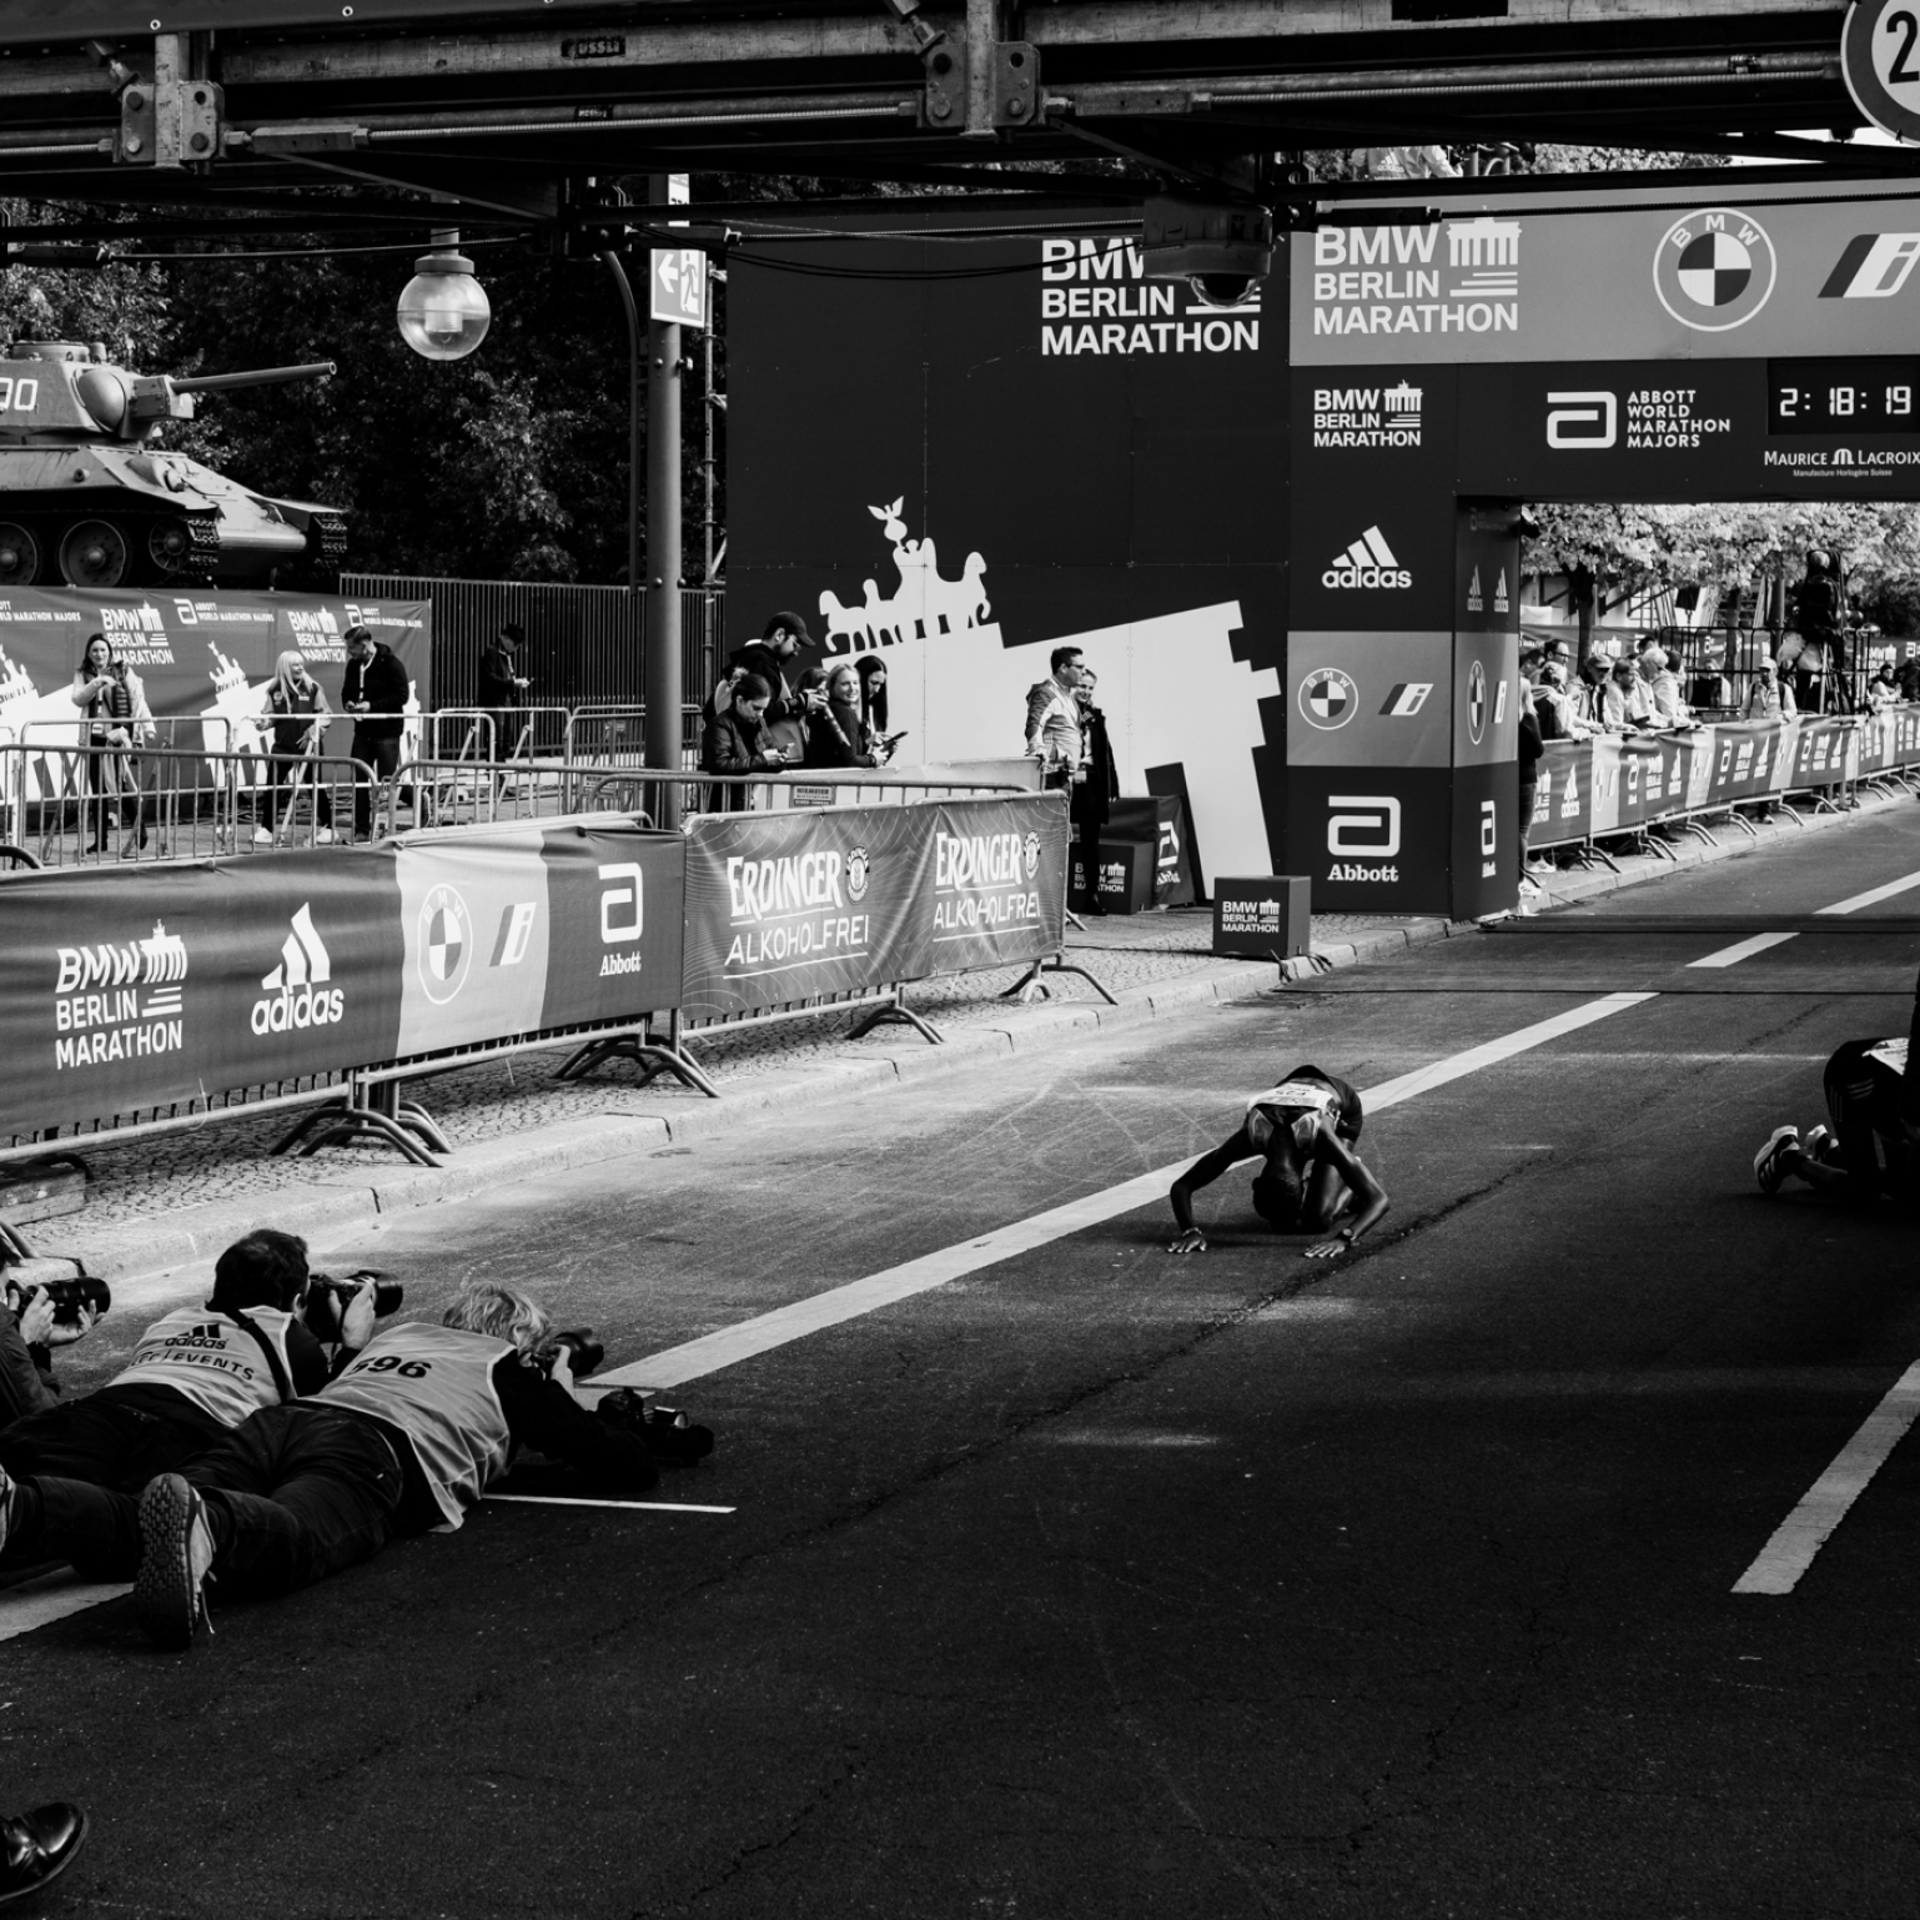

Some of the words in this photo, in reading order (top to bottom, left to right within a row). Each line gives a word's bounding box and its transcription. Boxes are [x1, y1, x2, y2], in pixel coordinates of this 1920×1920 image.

[1671, 213, 1760, 249] BMW
[1314, 224, 1438, 266] BMW
[1314, 270, 1439, 300] BERLIN
[1042, 286, 1174, 318] BERLIN
[1314, 303, 1518, 335] MARATHON
[1042, 320, 1260, 355] MARATHON
[1313, 389, 1380, 411] BMW
[1627, 390, 1696, 404] ABBOTT
[1313, 413, 1381, 429] BERLIN
[1627, 405, 1691, 418] WORLD
[1627, 419, 1731, 433] MARATHON
[1313, 431, 1421, 447] MARATHON
[1627, 434, 1701, 448] MAJORS
[1764, 450, 1828, 466] MAURICE
[1858, 450, 1919, 465] LACROIX
[1322, 566, 1412, 589] adidas
[100, 609, 139, 630] BMW
[287, 611, 321, 631] BMW
[107, 632, 147, 647] BERLIN
[935, 832, 1023, 891] ERDINGER
[1327, 864, 1399, 882] Abbott
[727, 851, 843, 920] ERDINGER
[933, 892, 1040, 930] ALKOHOLFREI
[1222, 902, 1258, 914] BMW
[1222, 914, 1258, 923] BERLIN
[1222, 923, 1279, 933] MARATHON
[724, 914, 869, 966] ALKOHOLFREI
[55, 941, 140, 993] BMW
[599, 951, 642, 976] Abbott
[56, 989, 138, 1031] BERLIN
[251, 983, 344, 1035] adidas
[55, 1019, 183, 1069] MARATHON
[165, 1336, 227, 1350] adidas
[173, 1352, 255, 1381] EVENTS
